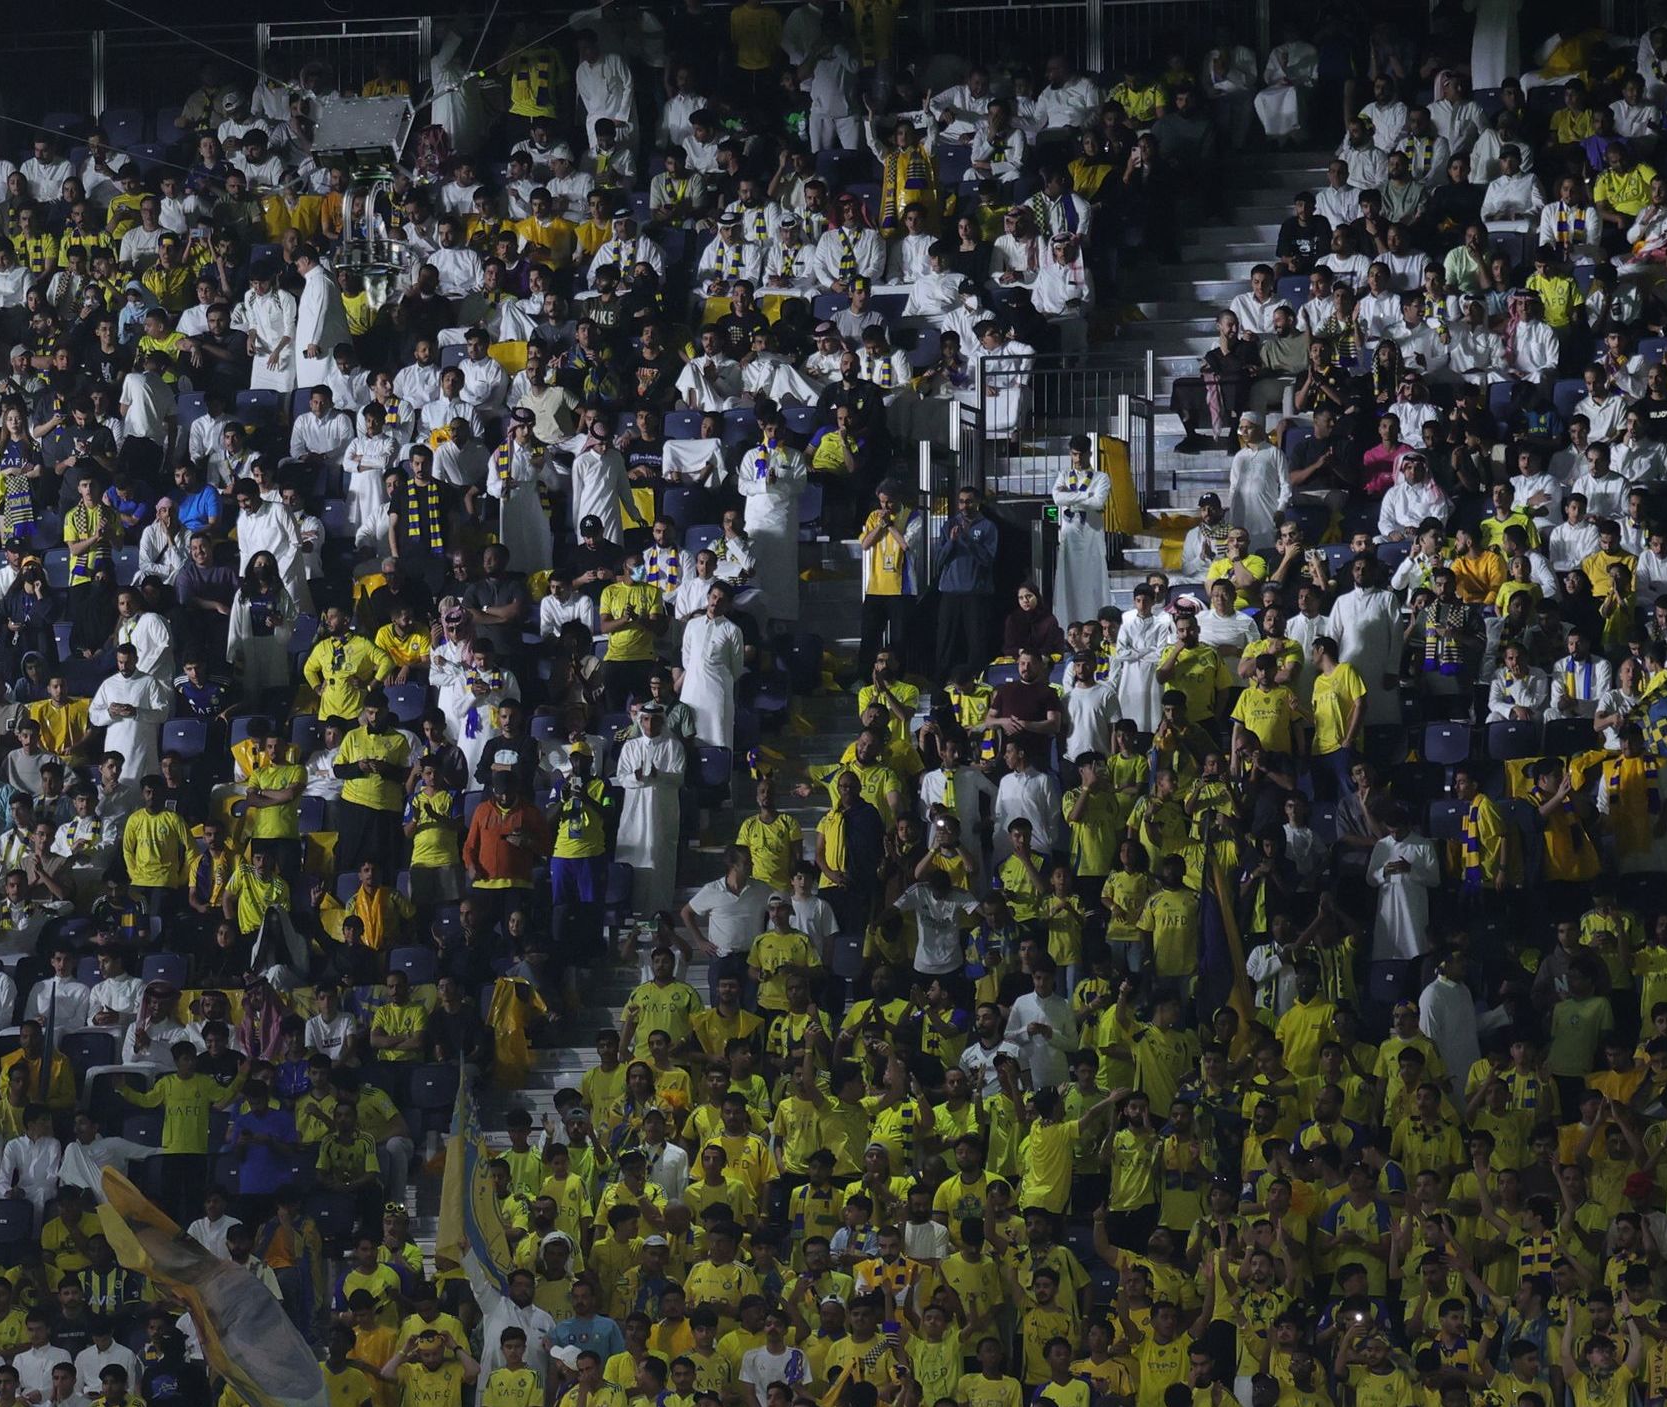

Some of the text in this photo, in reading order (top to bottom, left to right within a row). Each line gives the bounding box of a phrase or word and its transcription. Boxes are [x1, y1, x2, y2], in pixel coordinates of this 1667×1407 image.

[642, 1003, 677, 1013] KAFD
[168, 1106, 200, 1116] KAFD
[88, 1295, 116, 1306] AVIS
